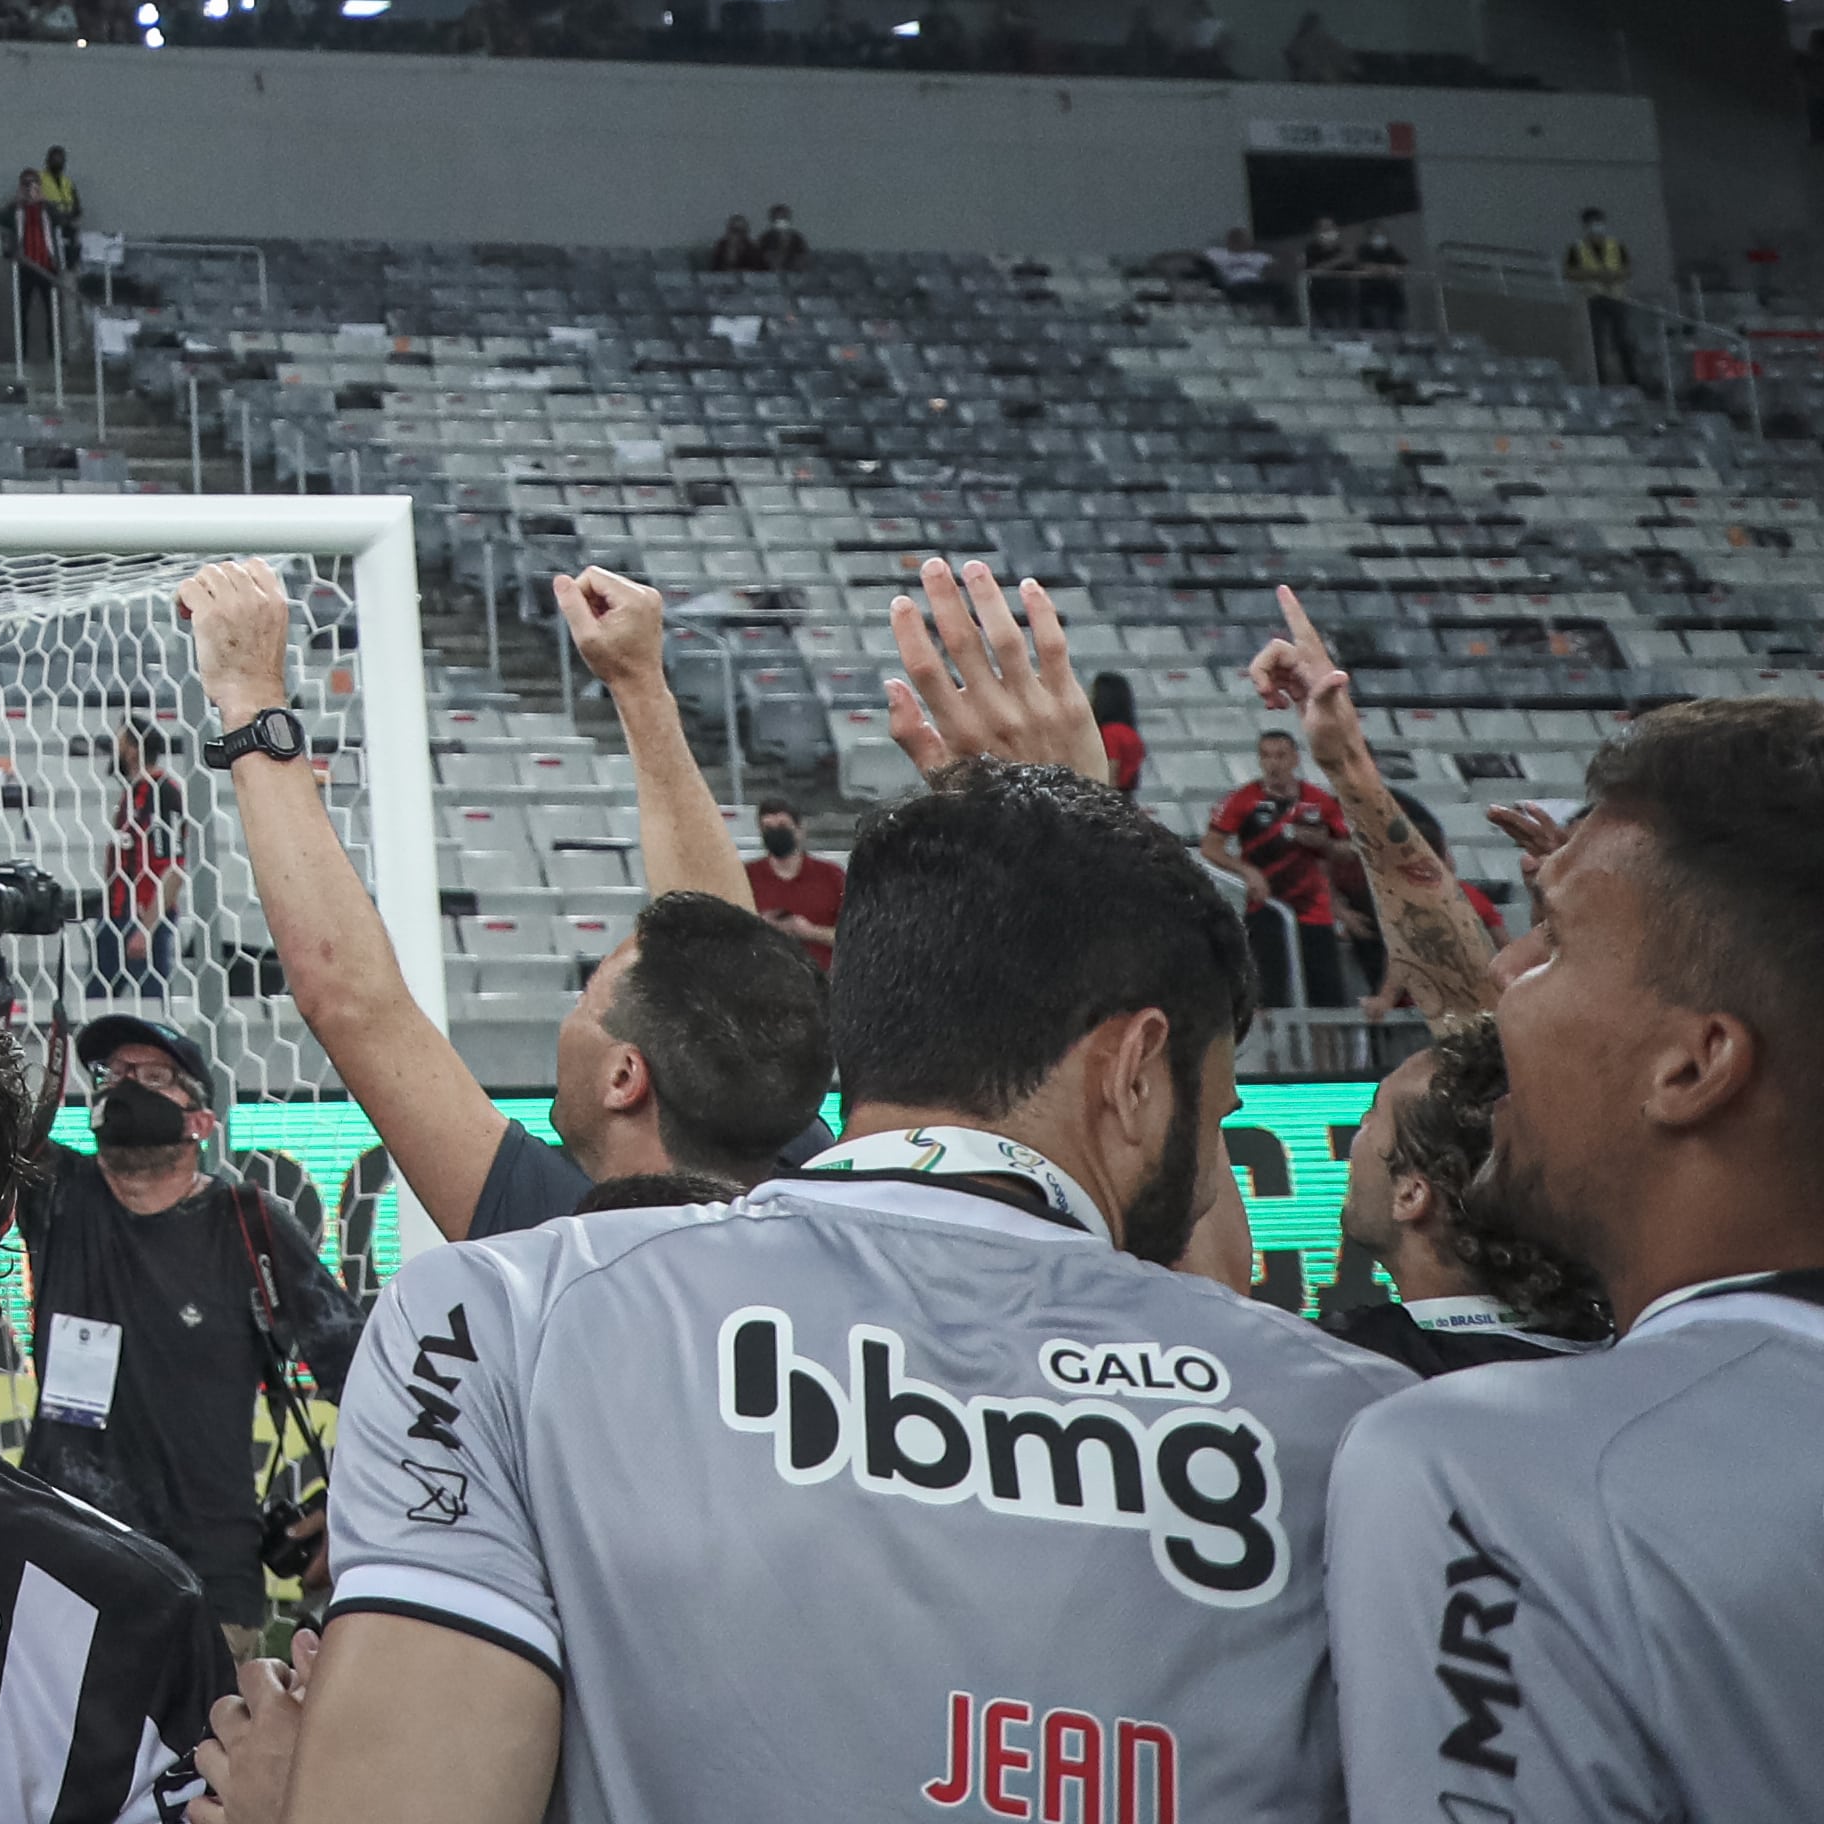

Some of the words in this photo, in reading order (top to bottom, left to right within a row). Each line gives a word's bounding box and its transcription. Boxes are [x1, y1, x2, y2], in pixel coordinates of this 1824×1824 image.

[1050, 1346, 1220, 1395] GALO
[1449, 1313, 1497, 1327] BRASIL
[859, 1338, 1278, 1594] bmg
[1434, 1510, 1523, 1780] MRV
[923, 1690, 1177, 1824] JEAN
